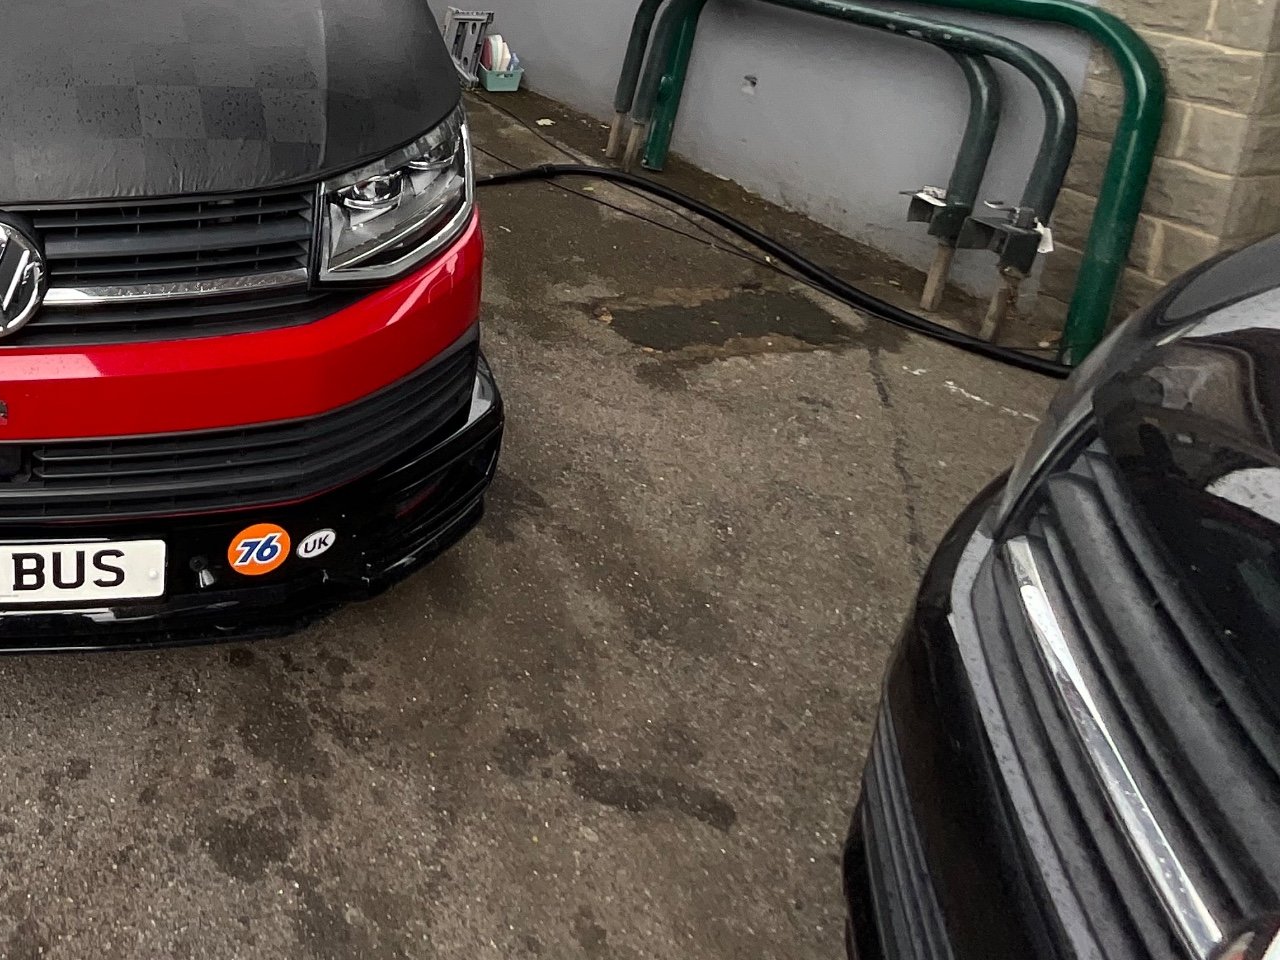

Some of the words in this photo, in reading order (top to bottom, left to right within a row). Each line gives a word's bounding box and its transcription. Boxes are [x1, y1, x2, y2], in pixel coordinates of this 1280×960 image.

[234, 532, 282, 566] 76
[303, 533, 330, 554] UK
[11, 548, 125, 591] BUS
